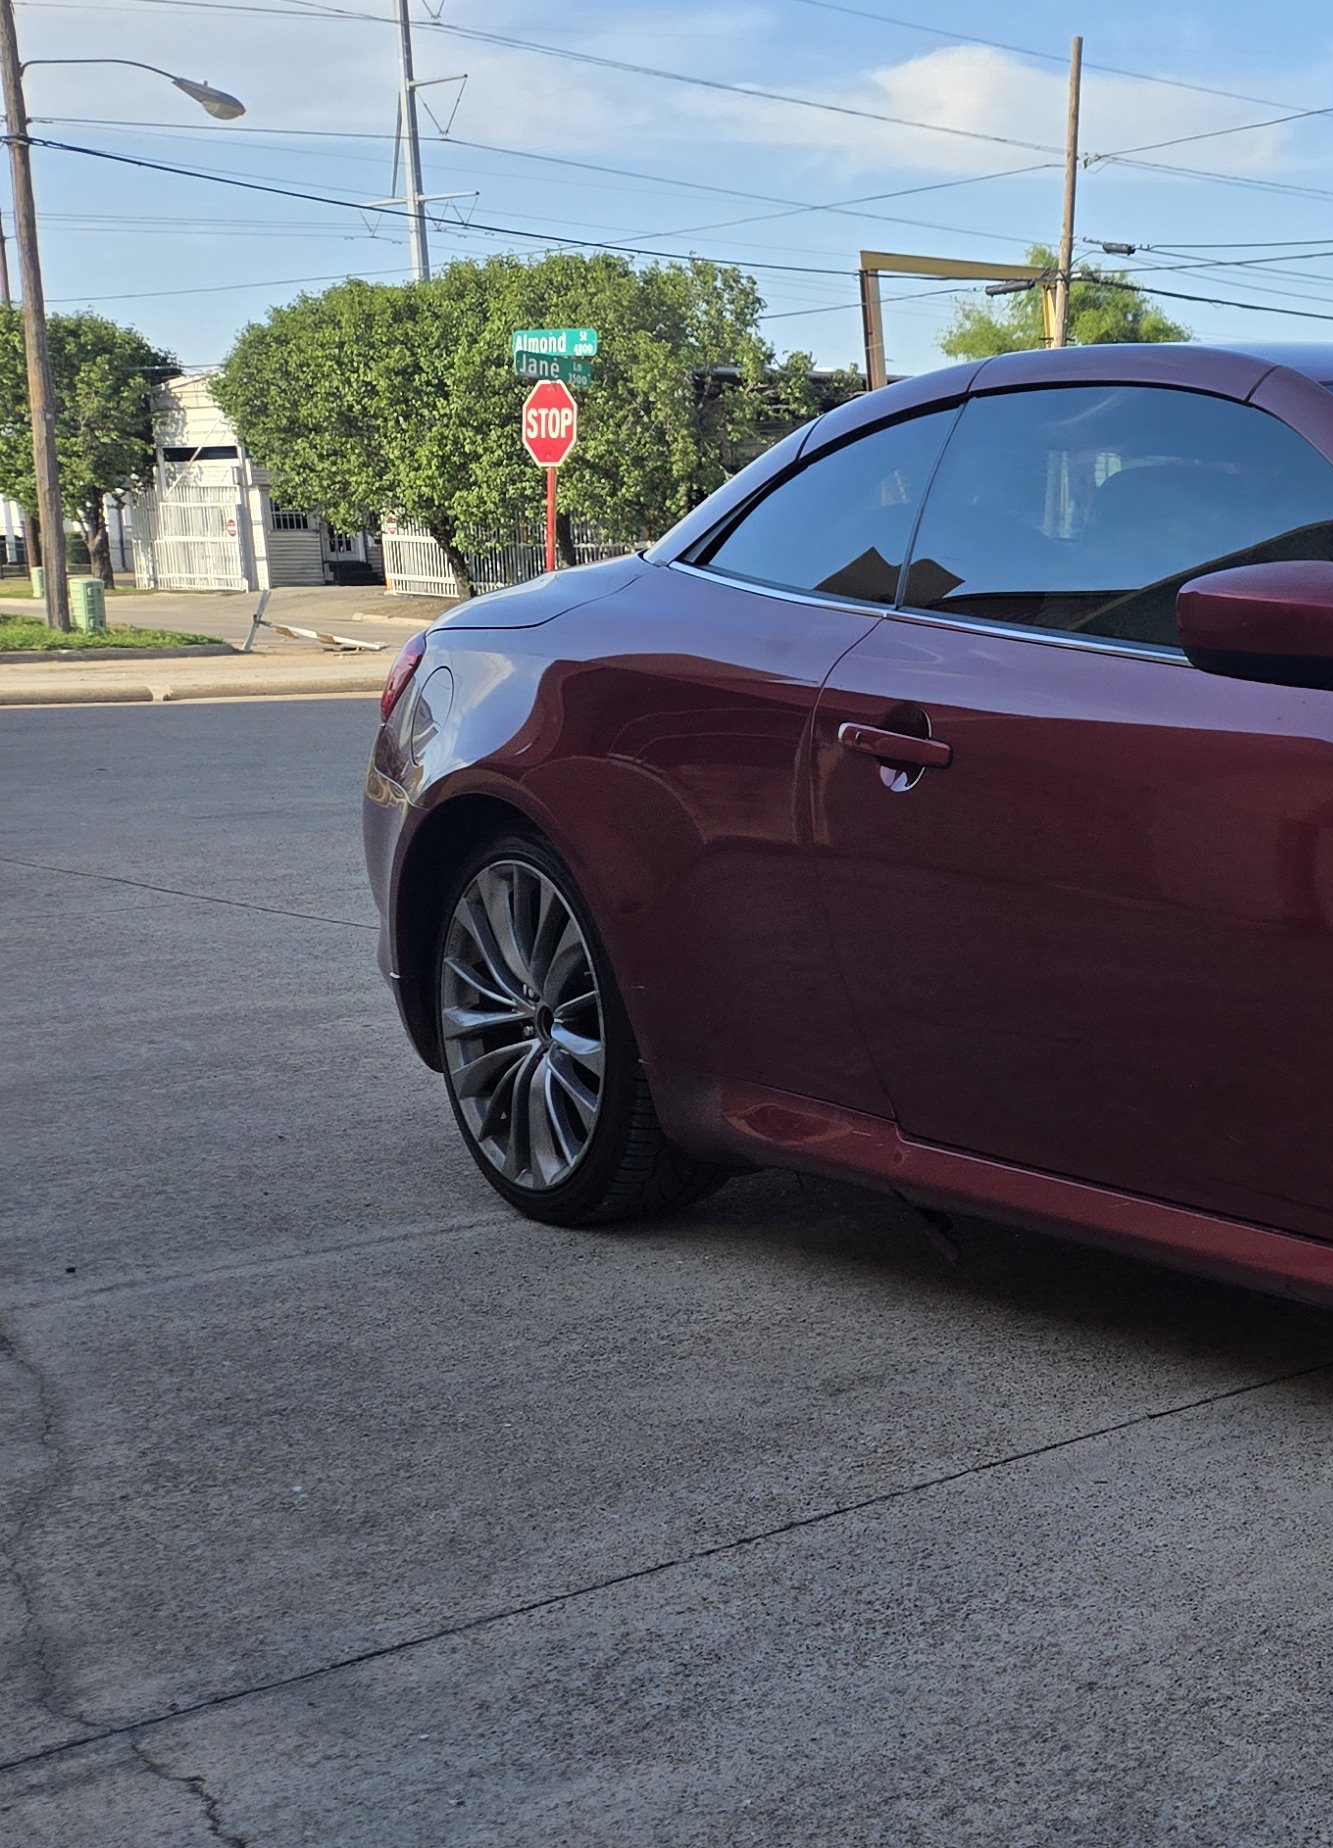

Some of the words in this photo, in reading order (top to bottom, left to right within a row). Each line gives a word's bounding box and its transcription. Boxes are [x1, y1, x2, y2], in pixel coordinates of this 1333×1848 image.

[515, 331, 567, 354] Almond
[519, 353, 560, 377] Jane
[573, 361, 583, 372] Ln
[526, 407, 573, 439] STOP
